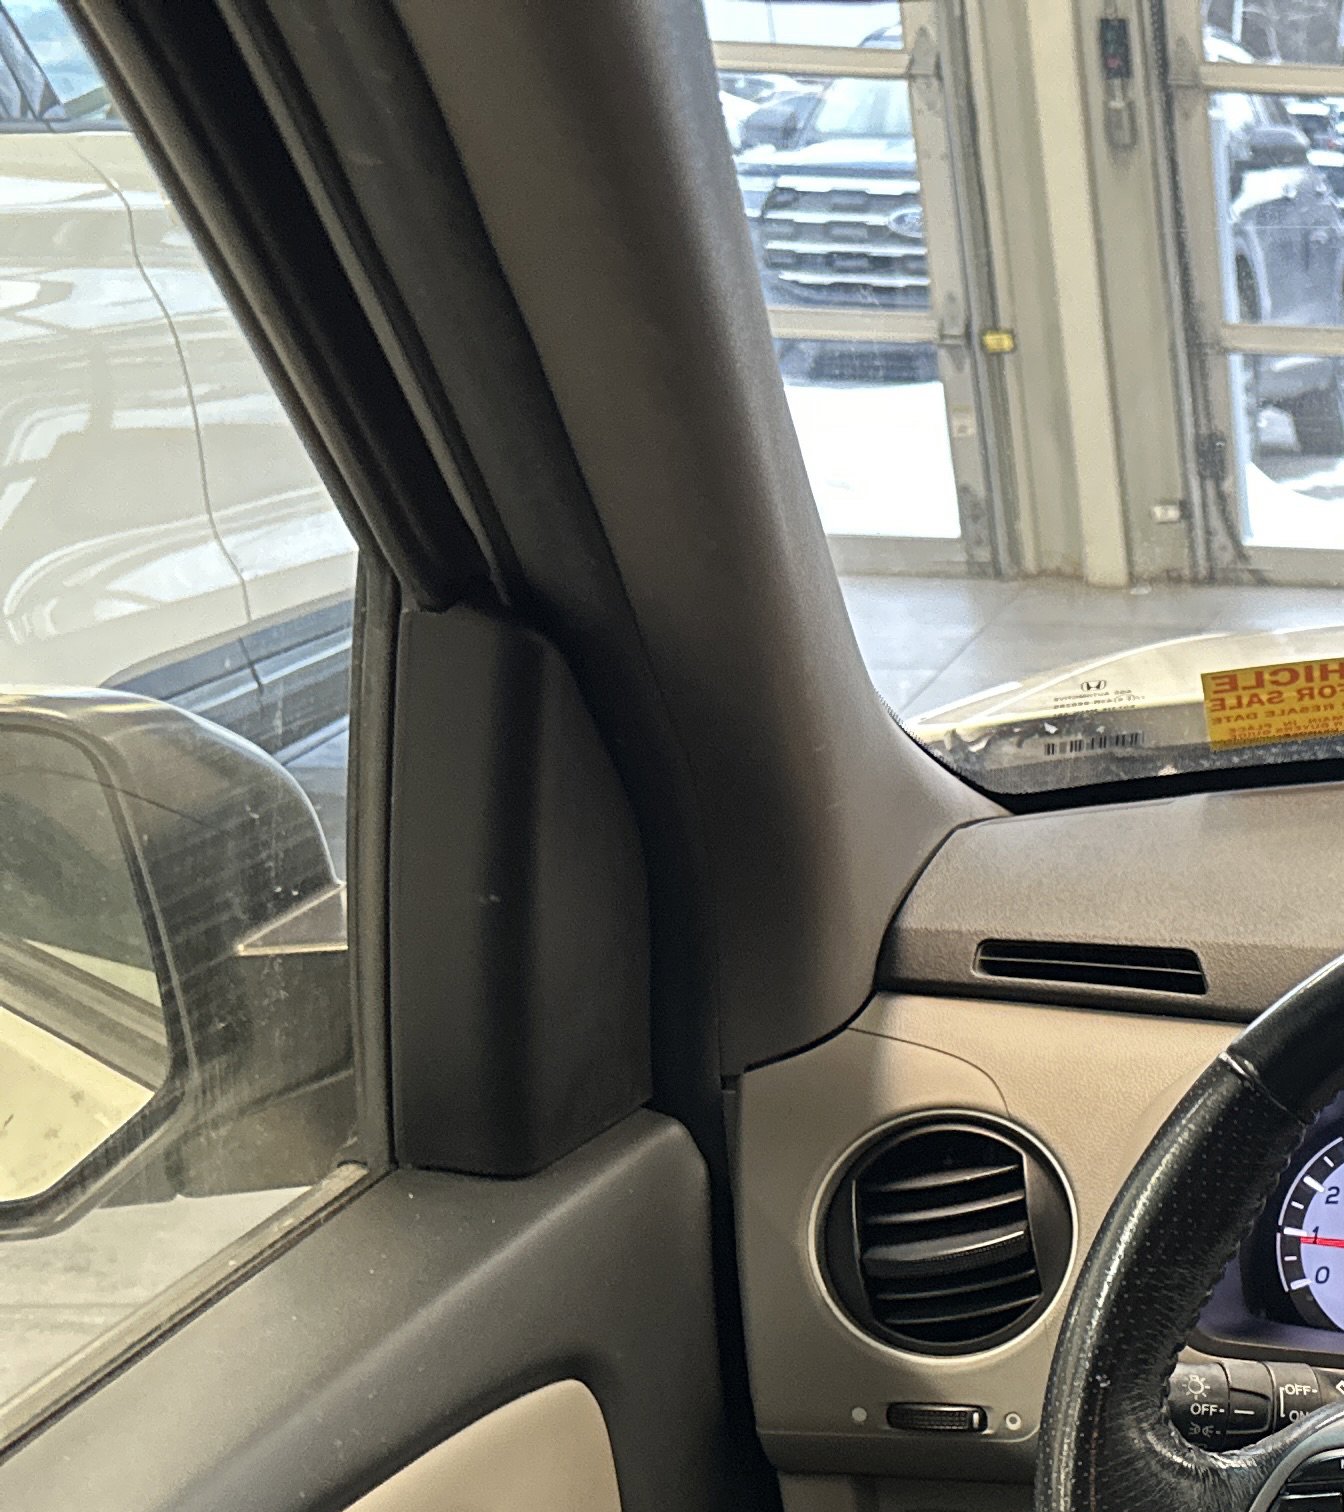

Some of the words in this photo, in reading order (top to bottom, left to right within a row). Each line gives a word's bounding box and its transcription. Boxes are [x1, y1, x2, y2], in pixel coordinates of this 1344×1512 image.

[1325, 1186, 1340, 1204] 2
[1311, 1226, 1320, 1244] 1
[1315, 1266, 1330, 1284] 0
[1285, 1383, 1312, 1396] OFF
[1190, 1403, 1218, 1416] OFF
